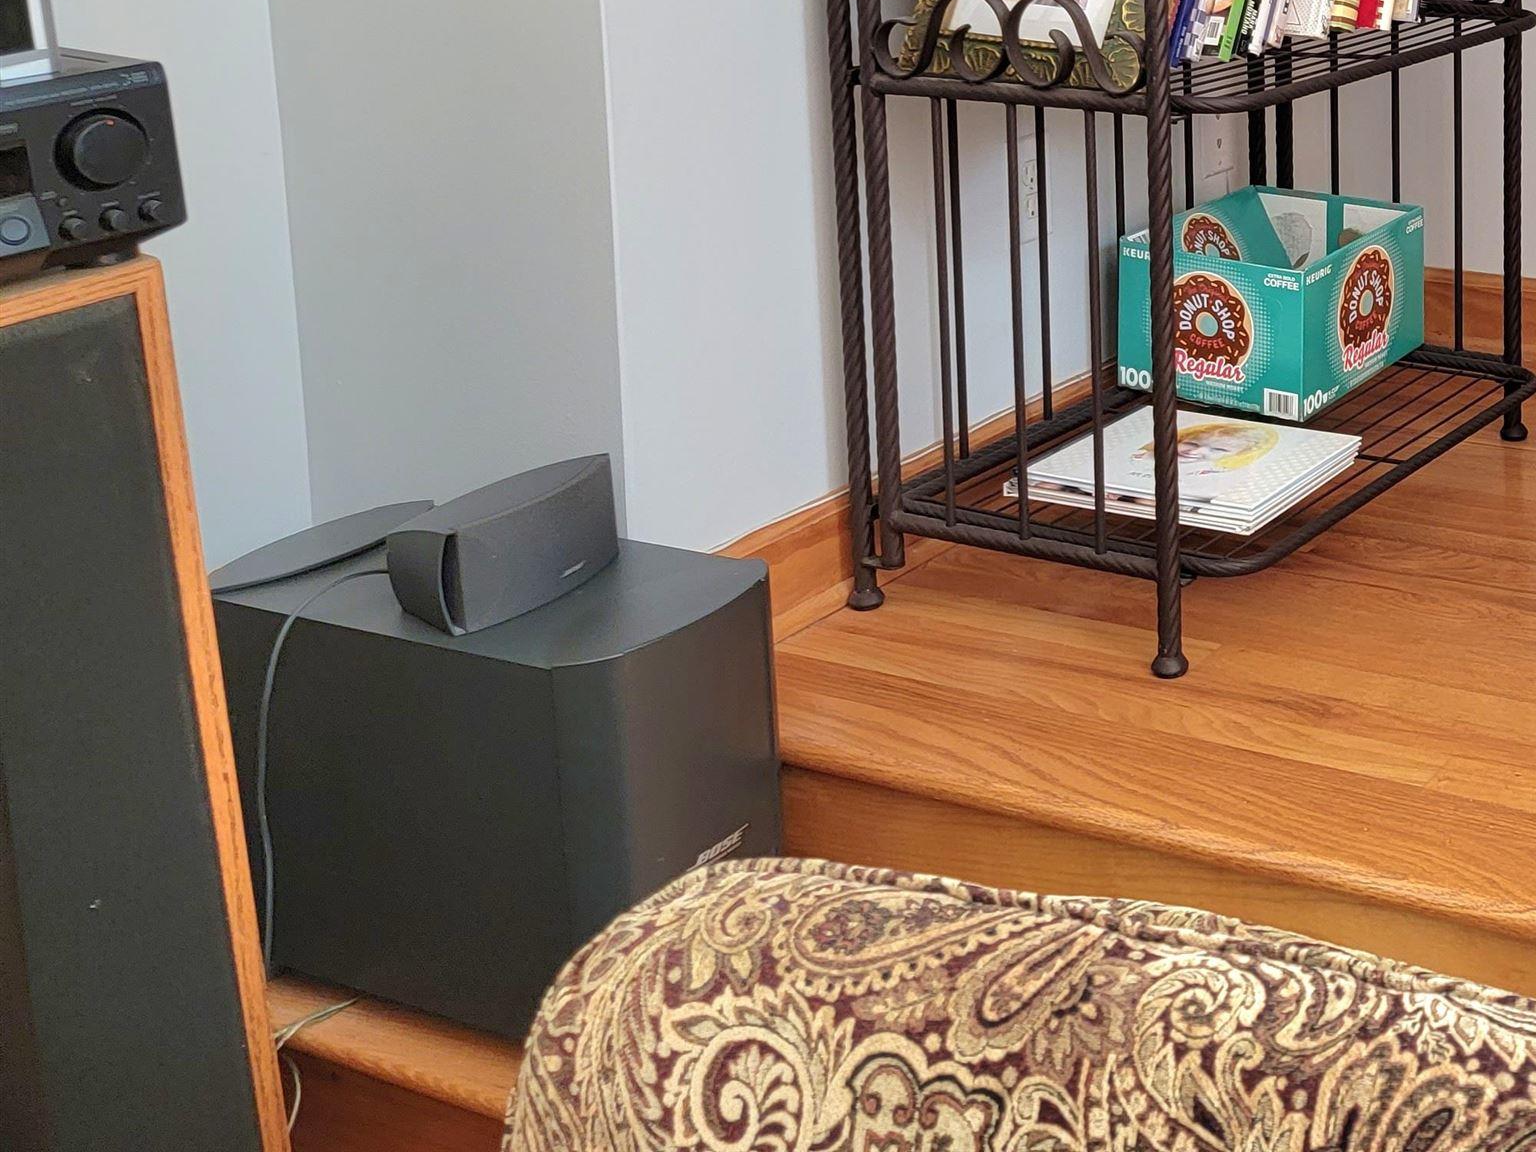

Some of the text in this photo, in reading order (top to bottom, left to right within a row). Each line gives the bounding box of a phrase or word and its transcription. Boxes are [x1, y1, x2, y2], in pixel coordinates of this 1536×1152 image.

[1240, 0, 1255, 35] MONTANO
[1248, 9, 1258, 29] MARK
[1405, 219, 1424, 234] COFFEE
[1123, 247, 1150, 260] KEUR
[1193, 230, 1230, 256] ONUT SHOP
[1264, 278, 1300, 291] COFFEE
[1306, 264, 1333, 286] KEURIG
[1349, 269, 1384, 324] DONUT SHOP
[1179, 293, 1236, 342] DONUT SHOP
[1355, 310, 1378, 331] COFFEE
[1189, 333, 1226, 349] COFFEE
[1343, 329, 1389, 373] Regular
[1175, 348, 1245, 384] Regular
[1120, 367, 1150, 389] 100
[1303, 389, 1322, 417] 100
